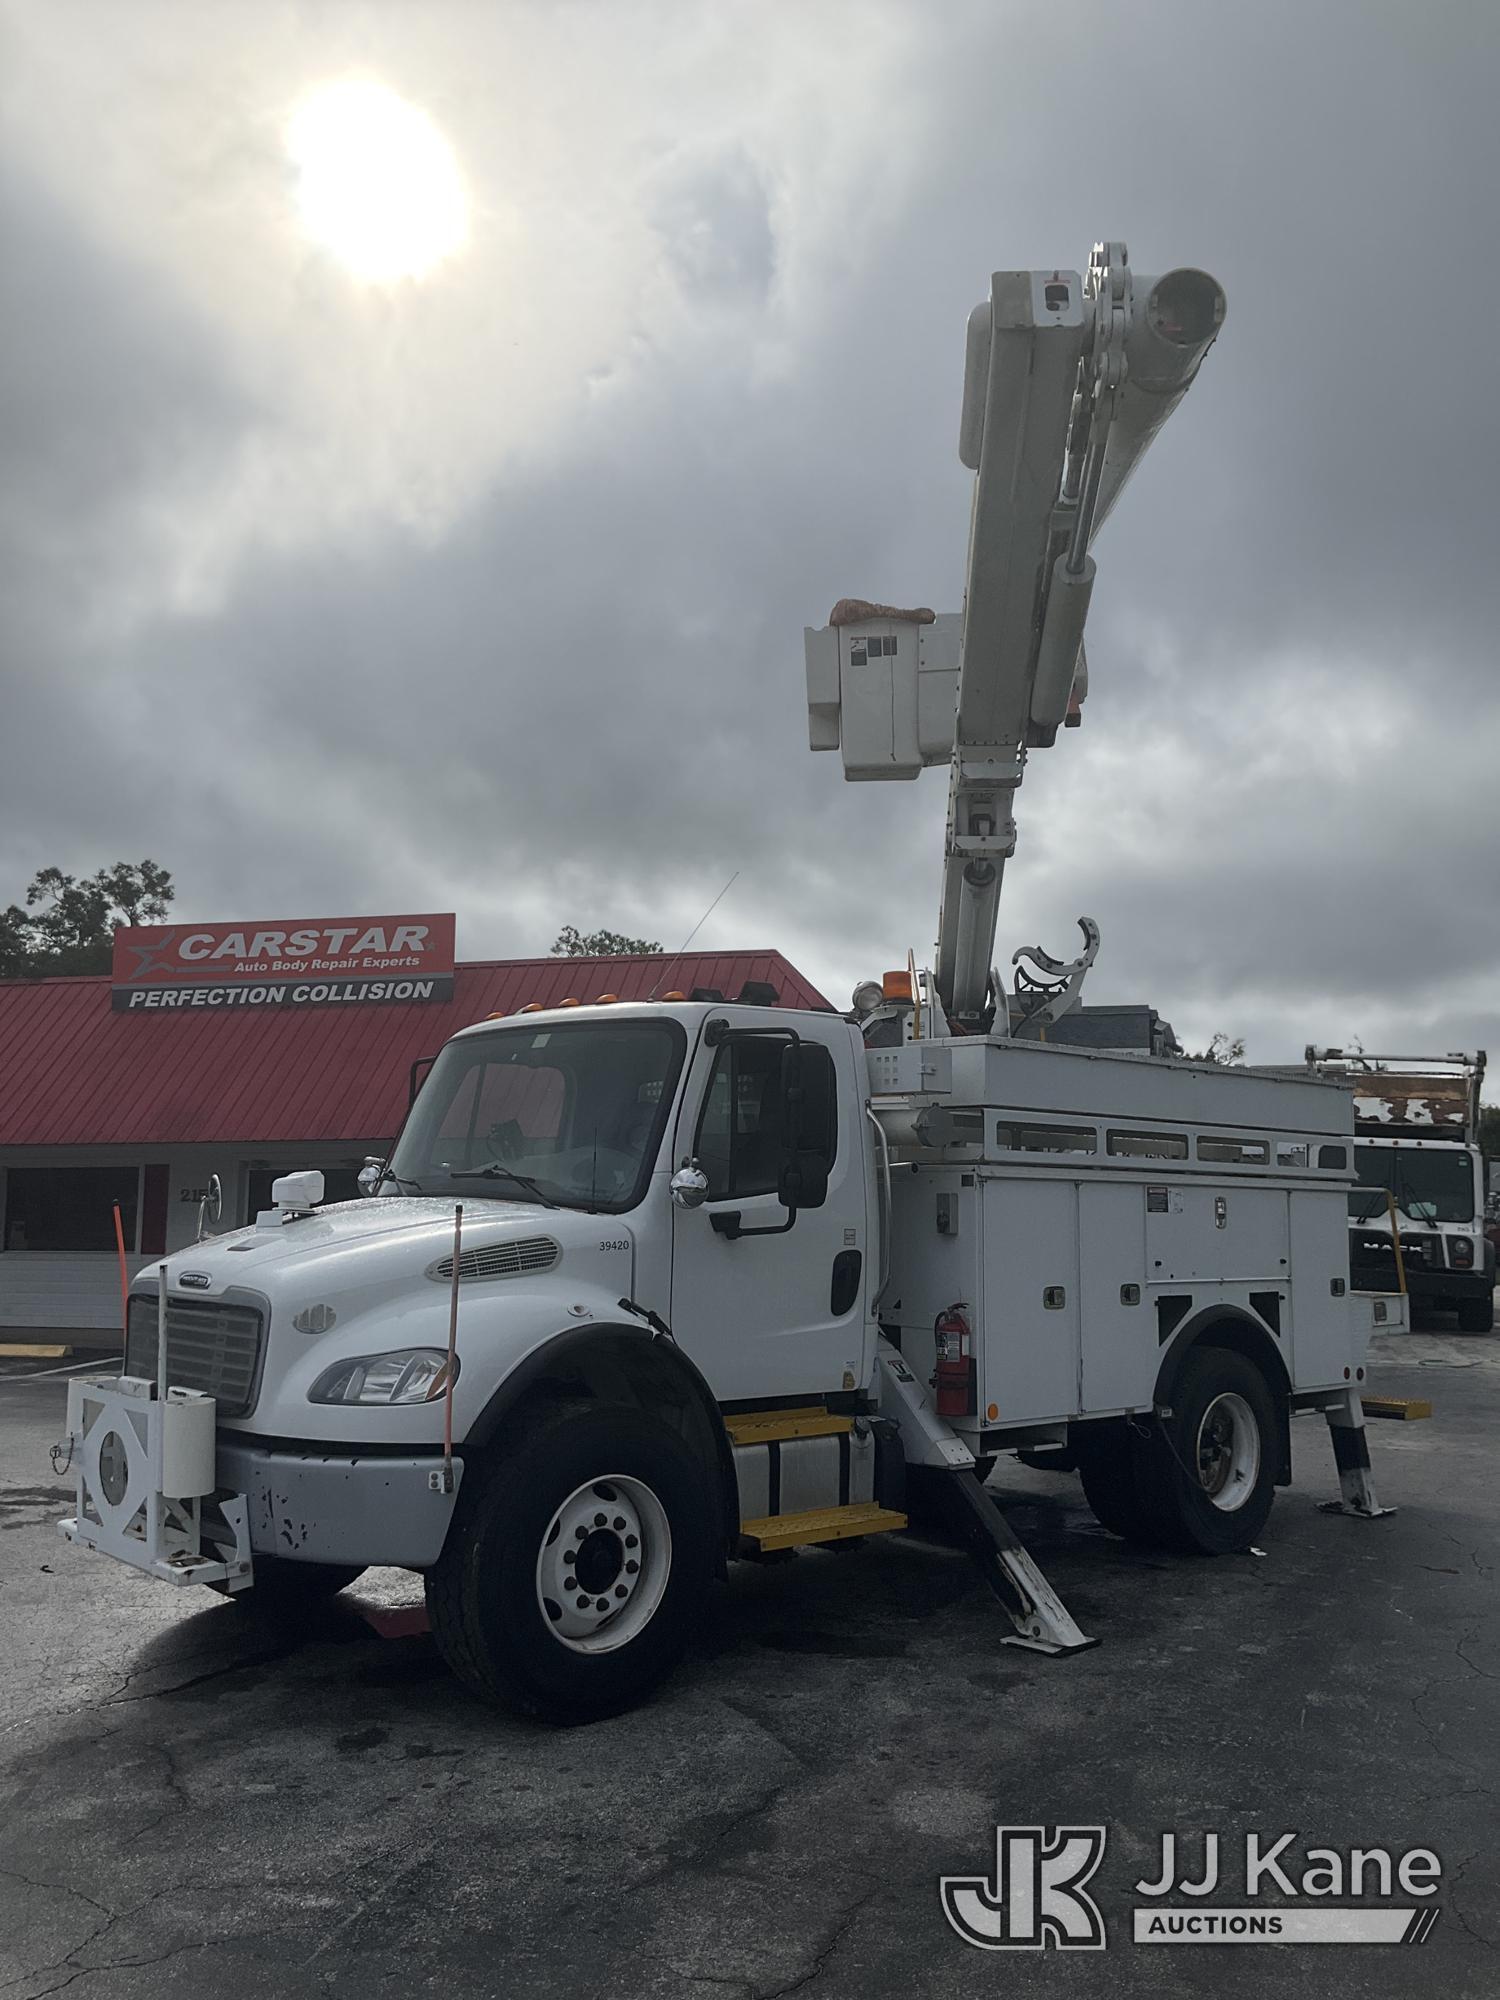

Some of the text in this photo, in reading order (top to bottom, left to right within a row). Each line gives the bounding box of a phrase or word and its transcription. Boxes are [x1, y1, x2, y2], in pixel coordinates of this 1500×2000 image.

[178, 925, 429, 960] CARSTAR
[234, 956, 420, 973] Auto Body Repair Experts
[128, 981, 434, 1008] PERFECTION COLLISION
[599, 1240, 630, 1251] 39420
